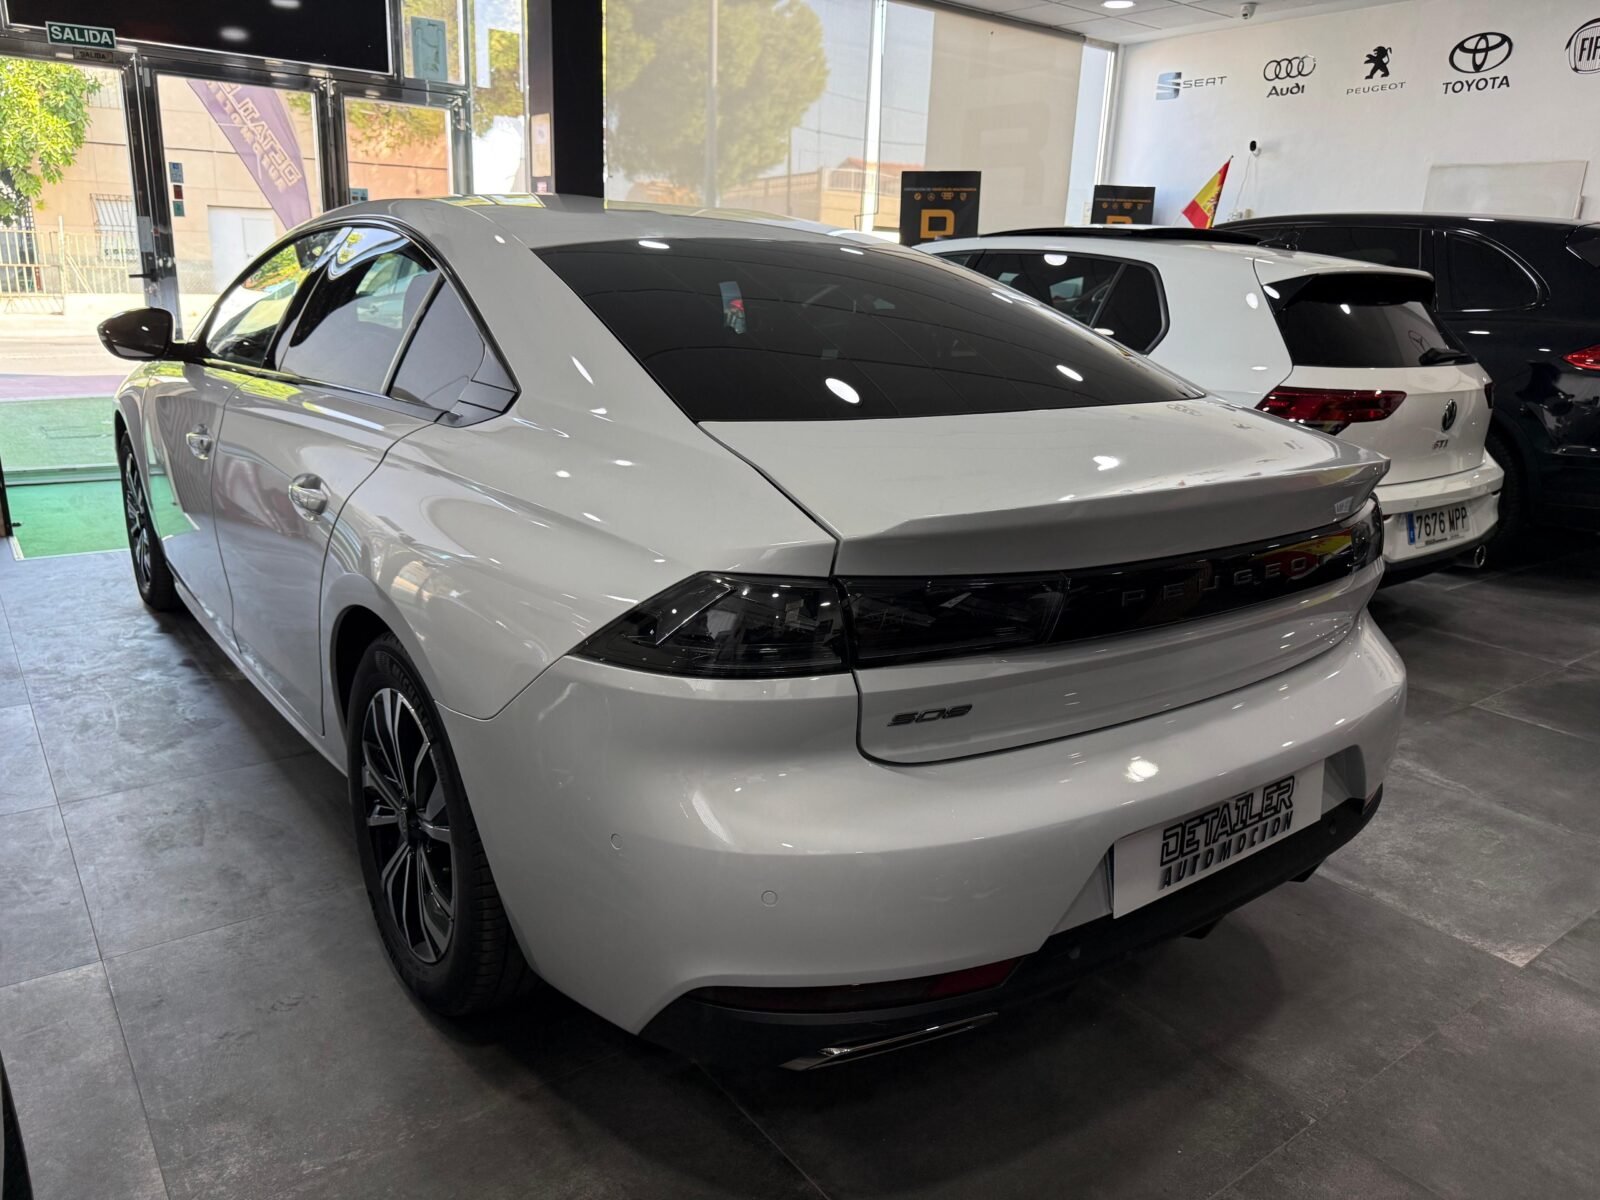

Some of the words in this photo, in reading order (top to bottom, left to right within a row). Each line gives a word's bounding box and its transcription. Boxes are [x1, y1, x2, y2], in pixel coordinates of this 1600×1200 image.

[51, 26, 112, 45] SALIDA
[1182, 76, 1227, 88] SEAT
[1266, 83, 1305, 98] Audi
[1346, 82, 1406, 95] PEUGEOT
[1442, 76, 1510, 94] TOYOTA
[1416, 511, 1445, 539] 7676
[1448, 507, 1467, 531] MPP
[887, 704, 972, 727] 508
[1160, 775, 1295, 867] DETAILER
[1158, 810, 1293, 890] AUTOMOCION
